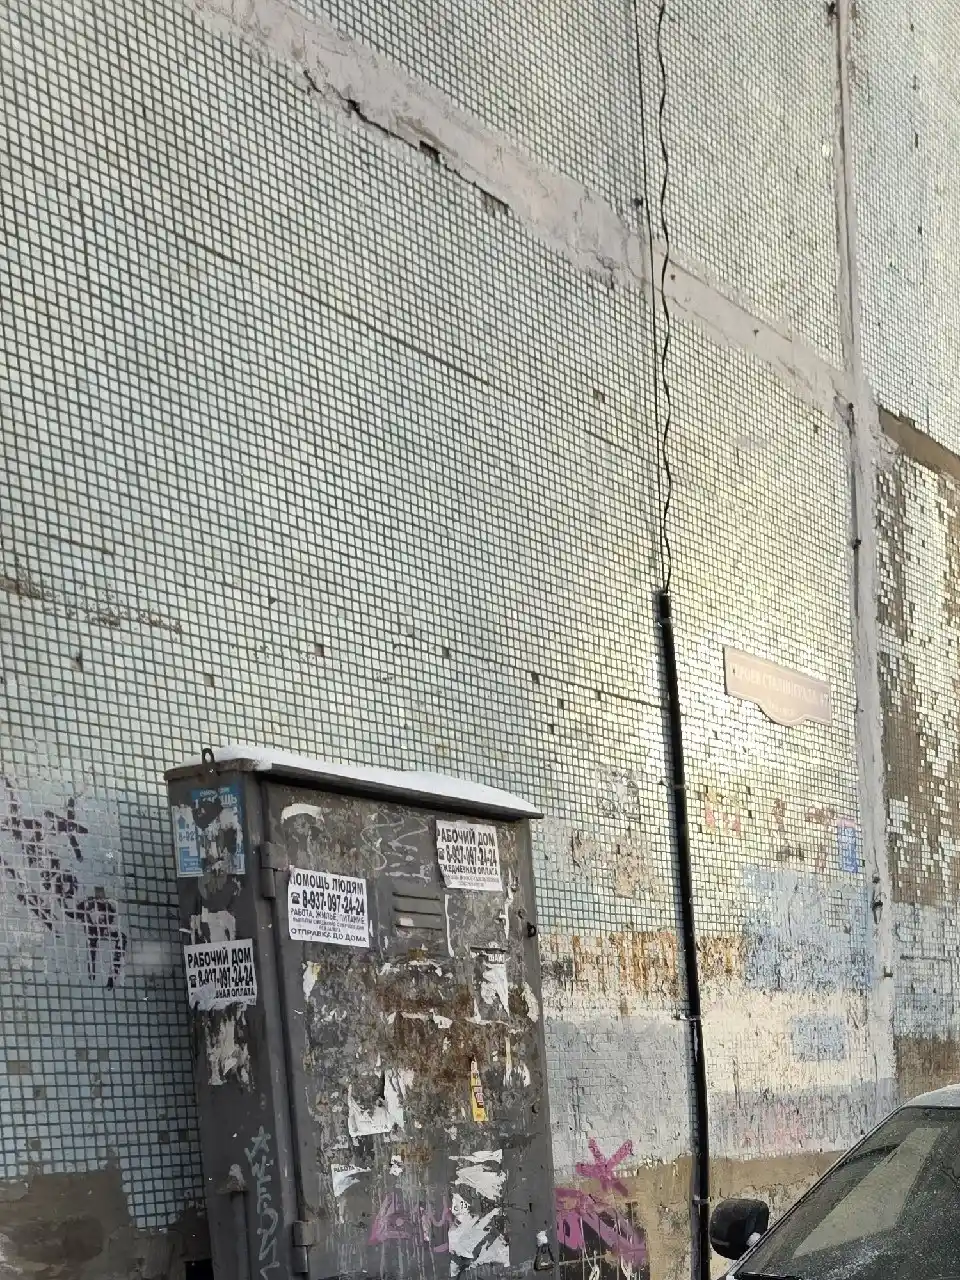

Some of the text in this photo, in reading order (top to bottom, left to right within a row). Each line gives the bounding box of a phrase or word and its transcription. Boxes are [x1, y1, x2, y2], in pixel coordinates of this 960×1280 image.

[478, 832, 496, 847] ДОМ
[440, 864, 476, 875] ЖЕДНЕВНАЯ
[332, 878, 364, 896] ЛЮДЯМ
[187, 947, 252, 968] РАБОЧИЙ ДОМ
